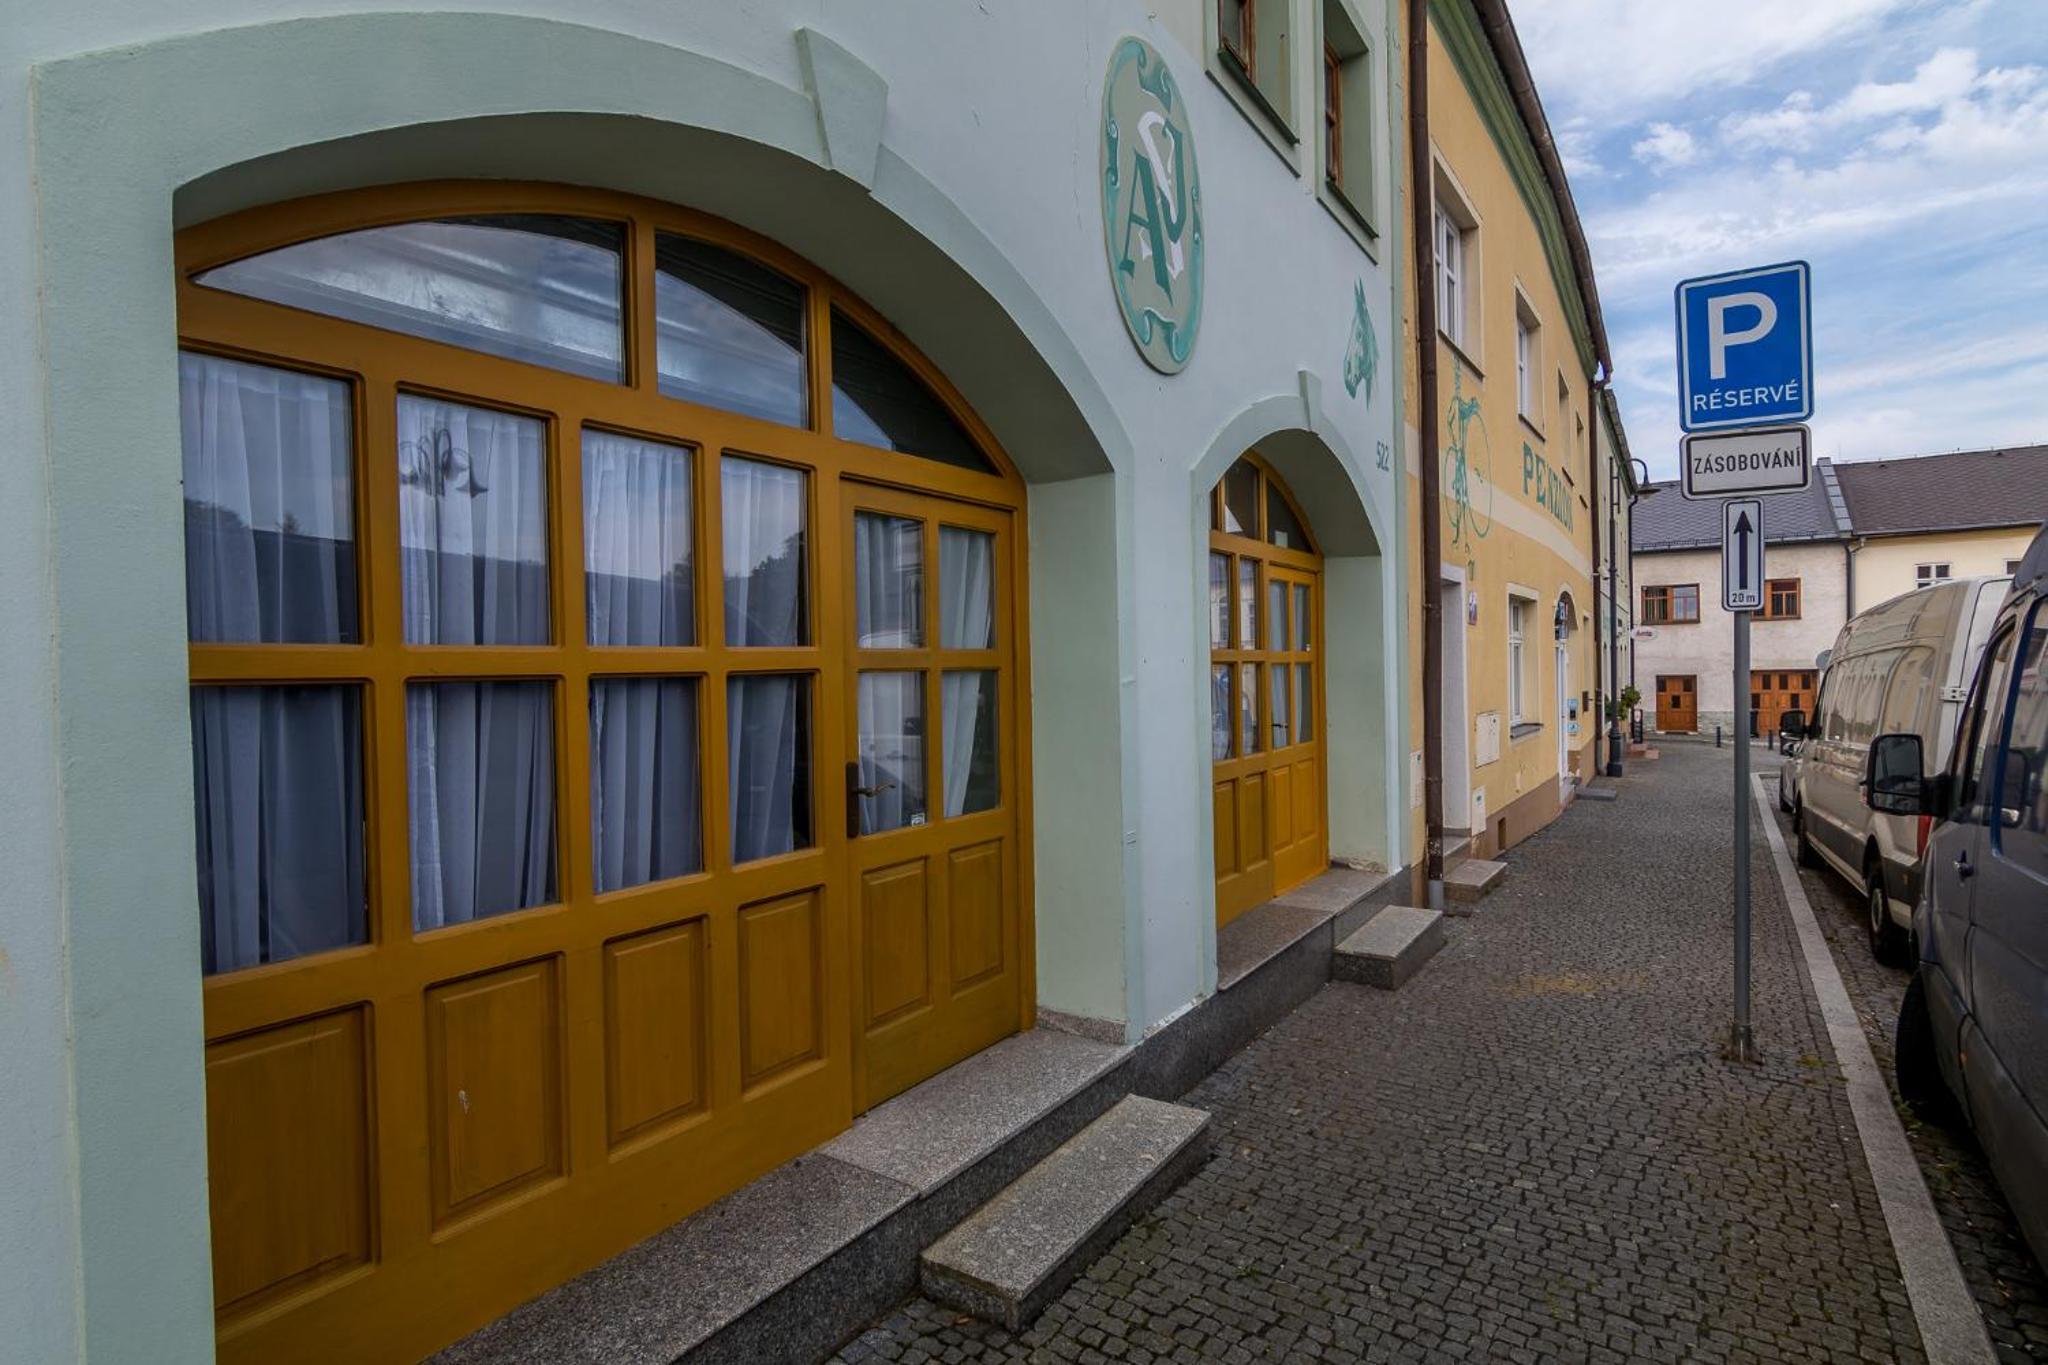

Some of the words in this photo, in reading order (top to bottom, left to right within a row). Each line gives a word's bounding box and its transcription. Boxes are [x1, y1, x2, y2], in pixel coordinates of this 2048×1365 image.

[1707, 291, 1778, 380] P
[1693, 379, 1799, 411] RÉSERVÉ
[1694, 447, 1801, 474] ZÁSOBOVÁNÍ
[1732, 592, 1744, 603] 20
[1746, 594, 1756, 603] m
